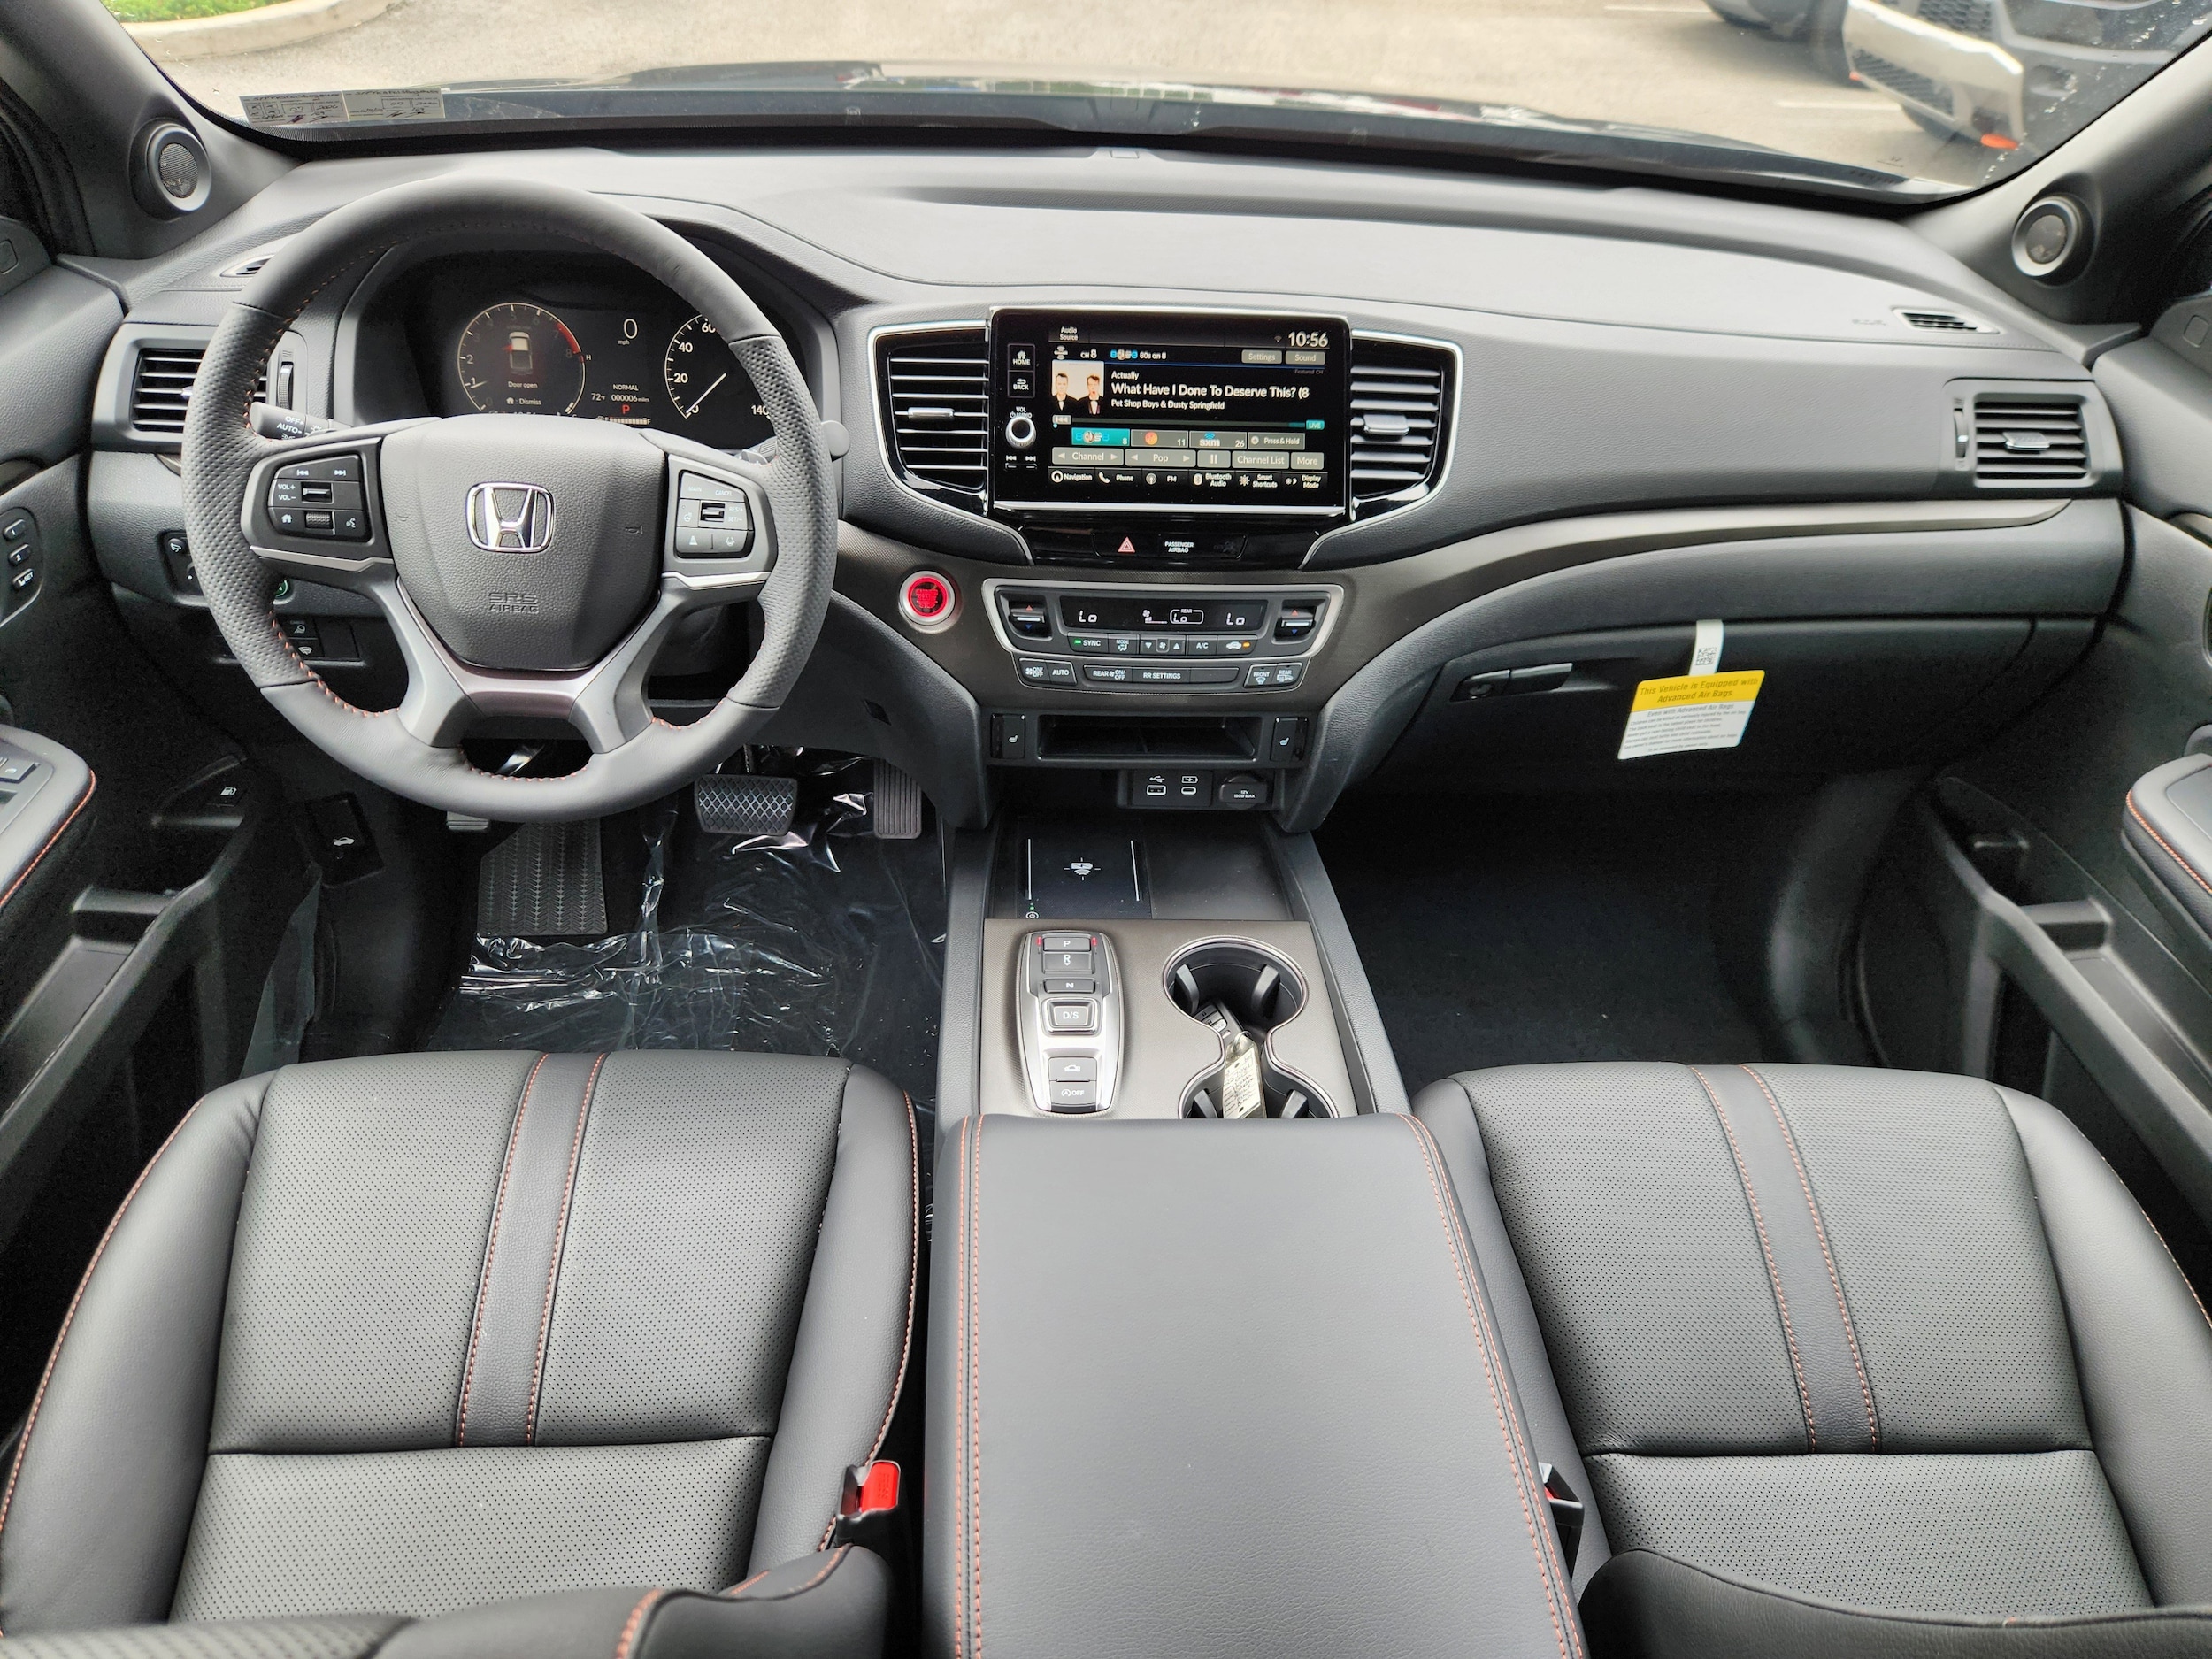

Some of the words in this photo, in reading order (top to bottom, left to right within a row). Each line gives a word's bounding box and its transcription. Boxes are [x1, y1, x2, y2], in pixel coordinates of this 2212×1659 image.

[624, 318, 638, 339] 0
[701, 323, 717, 334] 60
[1288, 331, 1329, 348] 10:56
[679, 342, 694, 353] 40
[466, 354, 474, 365] 2
[1090, 349, 1097, 359] 8
[1248, 353, 1276, 362] Settings
[673, 373, 689, 384] 20
[1111, 371, 1140, 380] Actually
[612, 383, 639, 392] NORMAL
[1111, 382, 1141, 395] What
[1143, 383, 1170, 396] Have
[1172, 384, 1176, 396] I
[1179, 384, 1207, 396] Done
[1210, 385, 1222, 396] To
[1225, 385, 1267, 398] Deserve
[1269, 386, 1295, 398] This?
[1298, 387, 1310, 399] (8
[611, 394, 638, 403] 000006
[622, 404, 631, 415] P
[1124, 399, 1141, 409] Shop
[1142, 400, 1159, 410] Boys
[1168, 401, 1188, 410] Dusty
[1189, 401, 1225, 411] Springfield
[276, 422, 298, 434] AUTO
[1071, 451, 1104, 461] Channel
[1153, 454, 1169, 464] Pop
[1237, 455, 1269, 465] Channel
[1271, 456, 1285, 465] List
[1296, 457, 1317, 465] More
[1064, 472, 1093, 482] Navigation
[1205, 472, 1232, 481] Bluetooth
[1301, 474, 1322, 484] Display
[1078, 610, 1098, 623] Lo
[1173, 612, 1188, 623] Lo
[1225, 612, 1246, 626] Lo
[1196, 641, 1209, 649] A/C
[1659, 684, 1688, 694] Vehicle
[1700, 680, 1740, 690] Equipped
[1656, 694, 1696, 703] Advanced
[1712, 689, 1733, 698] Bags
[1063, 954, 1071, 964] R
